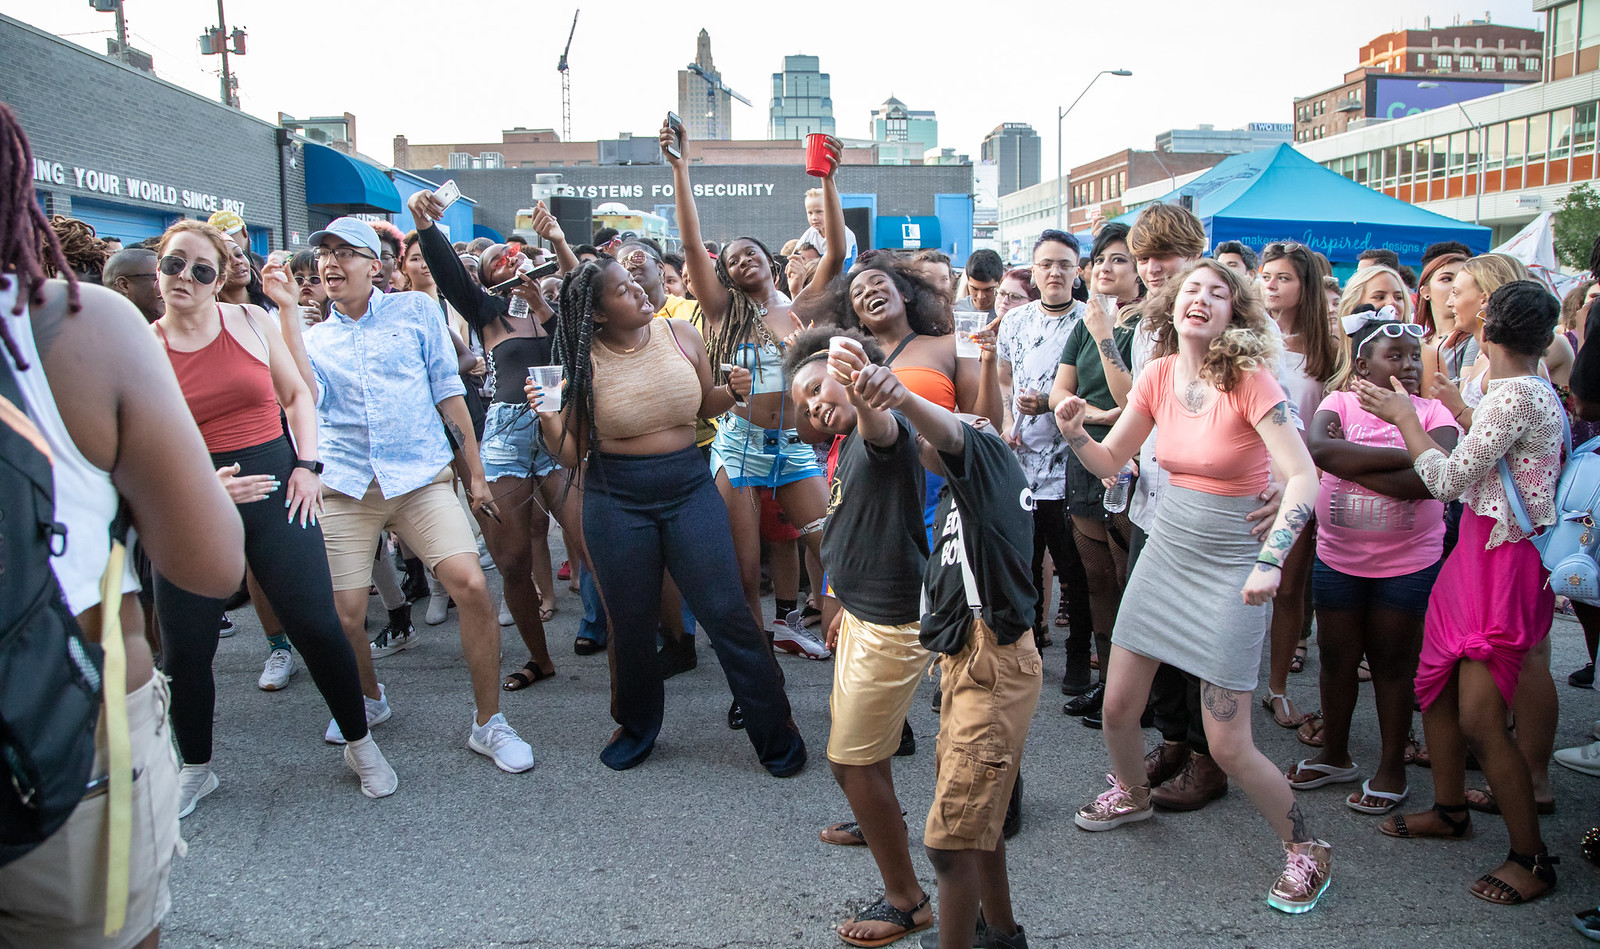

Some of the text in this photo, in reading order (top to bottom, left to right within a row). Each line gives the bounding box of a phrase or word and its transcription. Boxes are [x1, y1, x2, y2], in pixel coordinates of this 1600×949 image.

[1253, 123, 1272, 132] TWO
[73, 166, 120, 195] YOUR
[126, 177, 177, 205] WORLD
[181, 189, 217, 213] SINCE
[222, 197, 245, 217] 1897
[567, 183, 775, 198] SYSTEMS FO SECURITY
[1241, 235, 1279, 245] makers
[1382, 240, 1420, 254] designs
